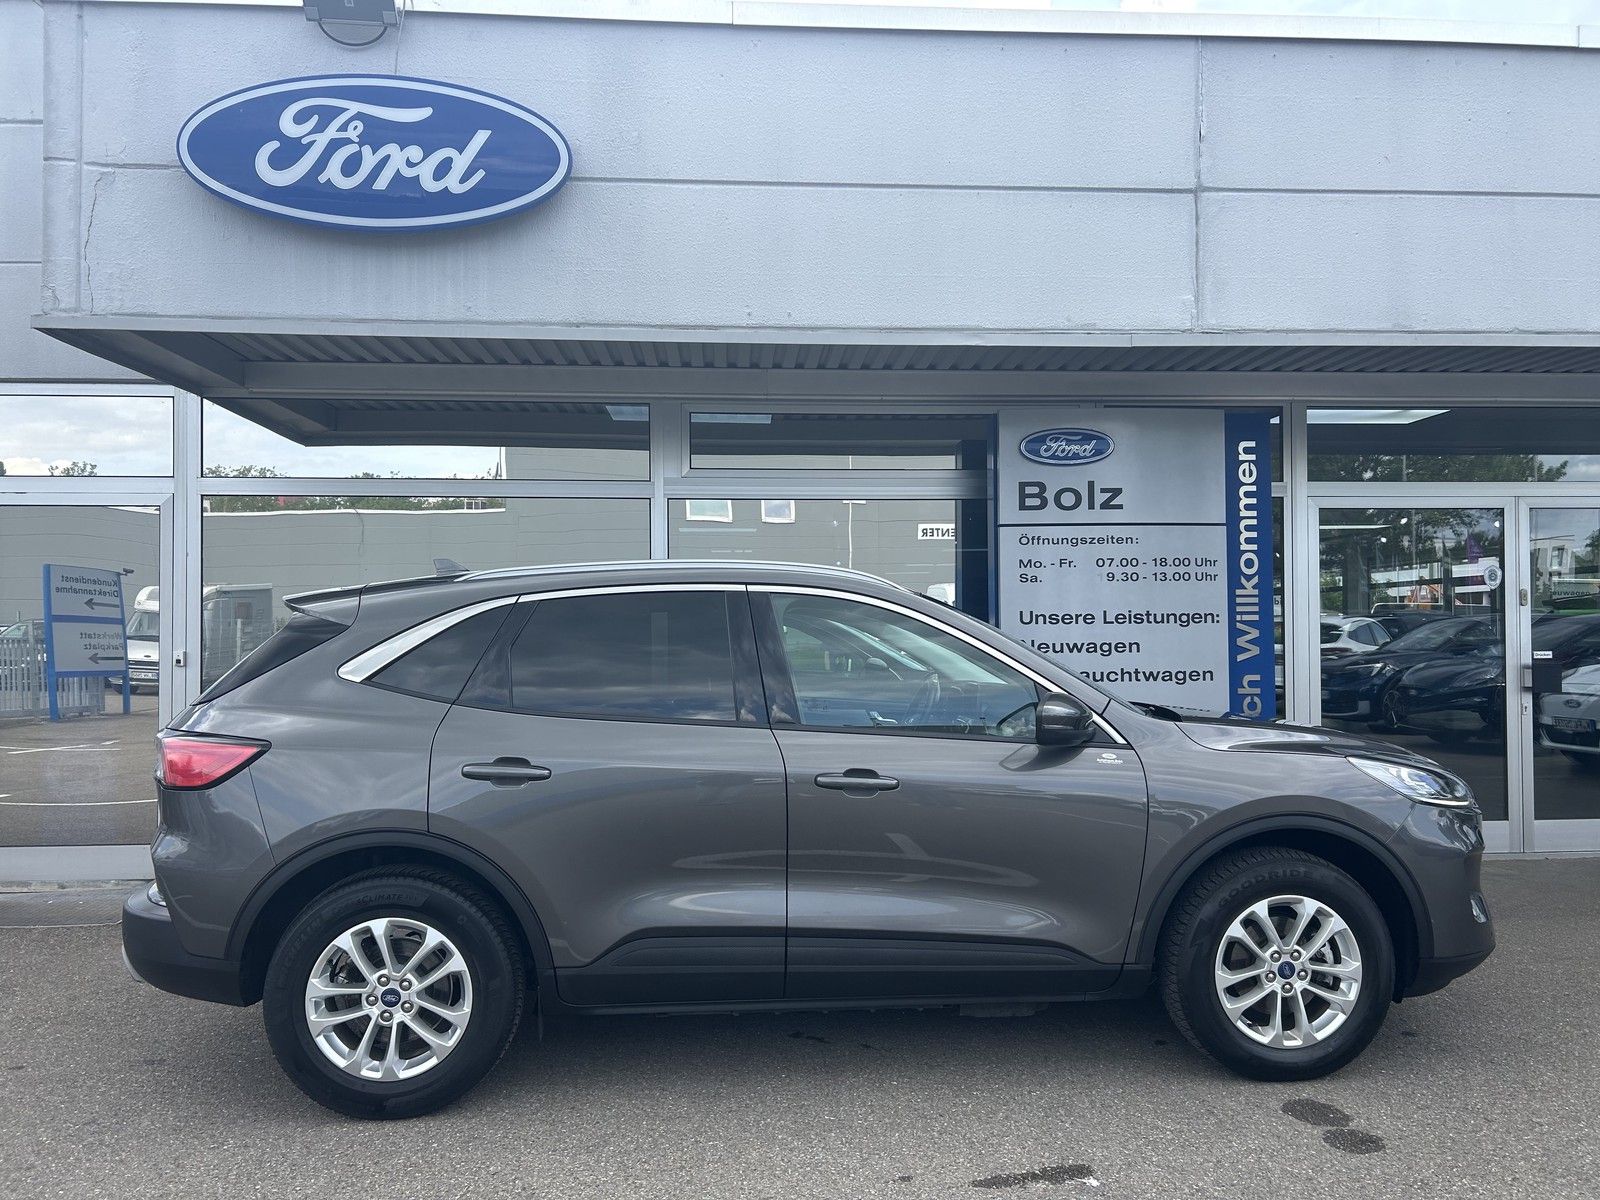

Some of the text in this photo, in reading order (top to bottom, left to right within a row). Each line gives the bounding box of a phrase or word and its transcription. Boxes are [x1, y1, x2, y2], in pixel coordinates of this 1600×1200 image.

[254, 97, 492, 195] Ford
[1039, 434, 1097, 457] Ford
[1018, 480, 1124, 511] Bolz
[1018, 533, 1139, 547] Öffnungszeiten:
[1018, 558, 1047, 569] Mo.
[1059, 558, 1077, 569] Fr.
[1095, 557, 1139, 568] 07.00
[1152, 557, 1191, 567] 18.00
[1195, 557, 1218, 567] Uhr
[1019, 573, 1043, 583] Sa.
[1106, 571, 1140, 582] 9.30
[1152, 571, 1191, 582] 13.00
[1195, 572, 1218, 582] Uhr
[1235, 440, 1262, 718] ch Willkommen
[1019, 610, 1220, 628] Unsere Leistungen:
[1080, 667, 1214, 685] auchtwagen
